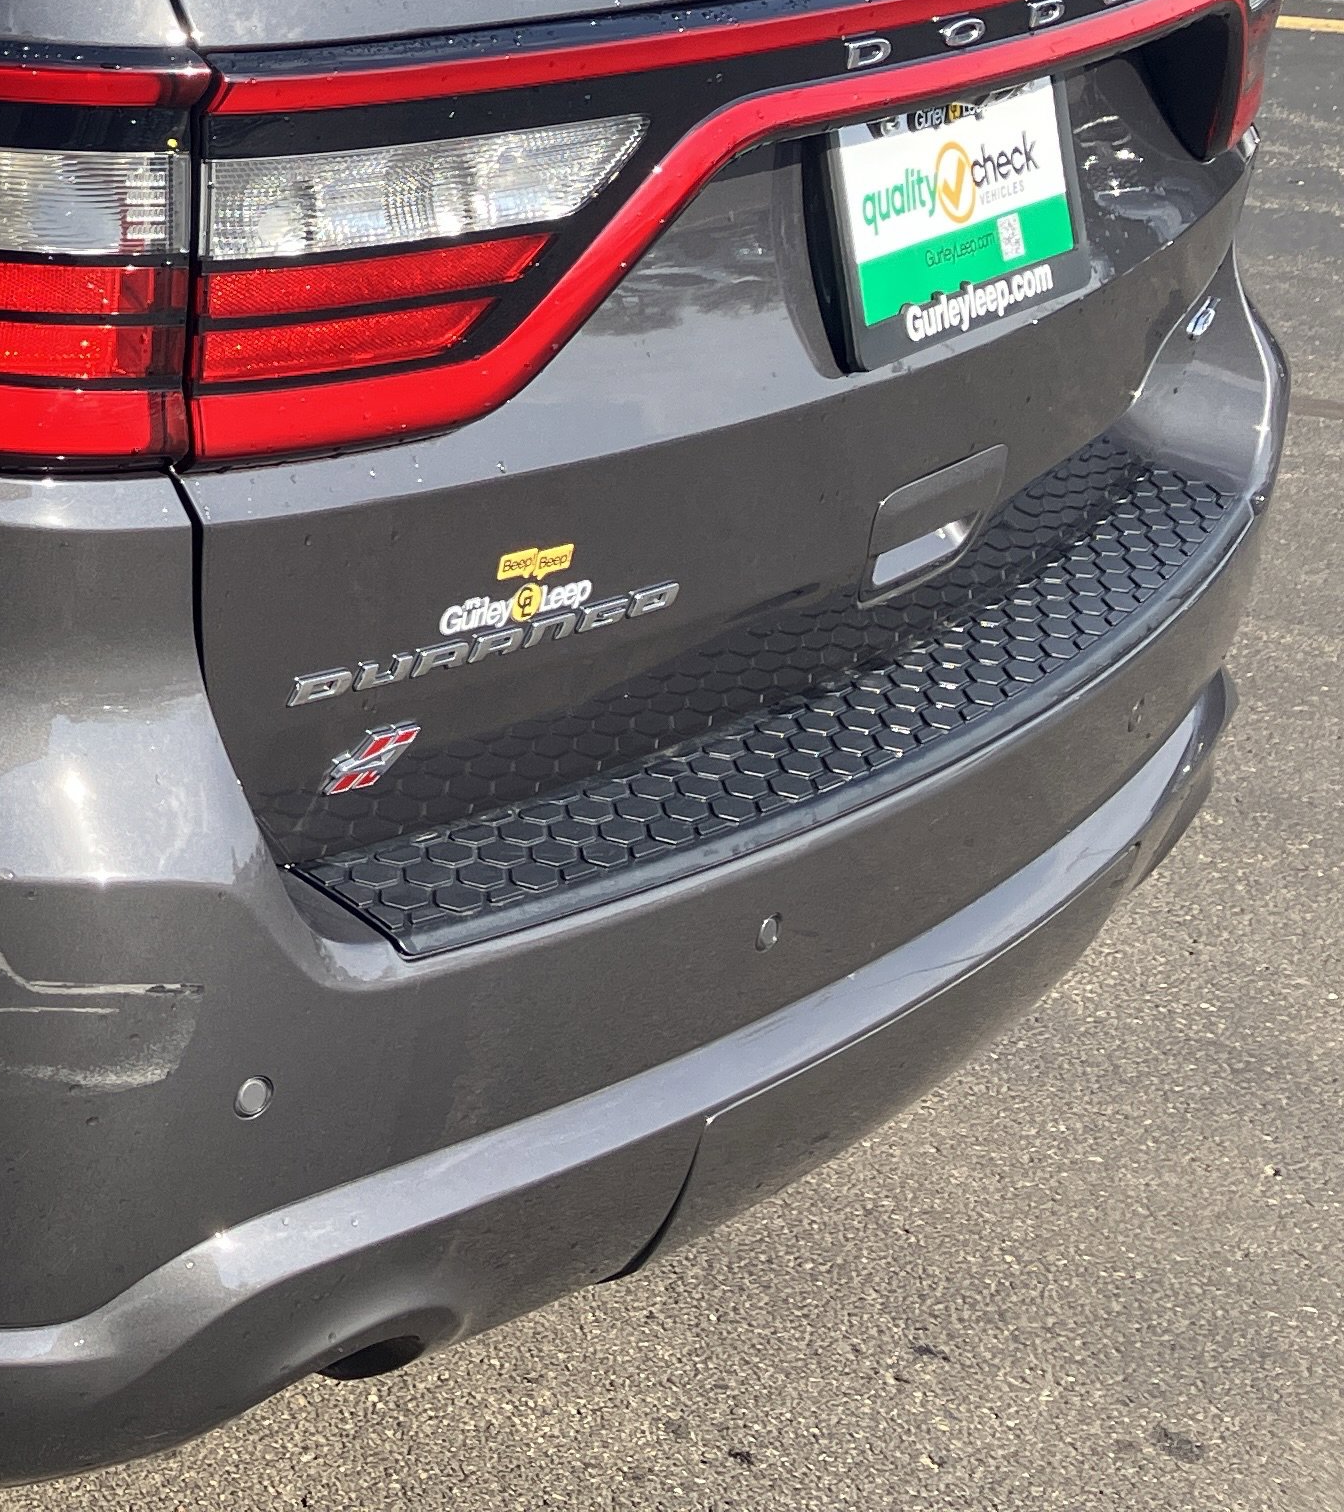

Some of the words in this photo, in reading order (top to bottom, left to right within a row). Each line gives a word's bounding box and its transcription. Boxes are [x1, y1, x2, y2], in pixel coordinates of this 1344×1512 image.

[862, 168, 939, 236] quality
[971, 130, 1040, 187] check
[980, 180, 1026, 206] VEHICLES
[286, 579, 680, 708] DURANGO
[439, 595, 514, 636] Gurley
[539, 579, 592, 609] Leep
